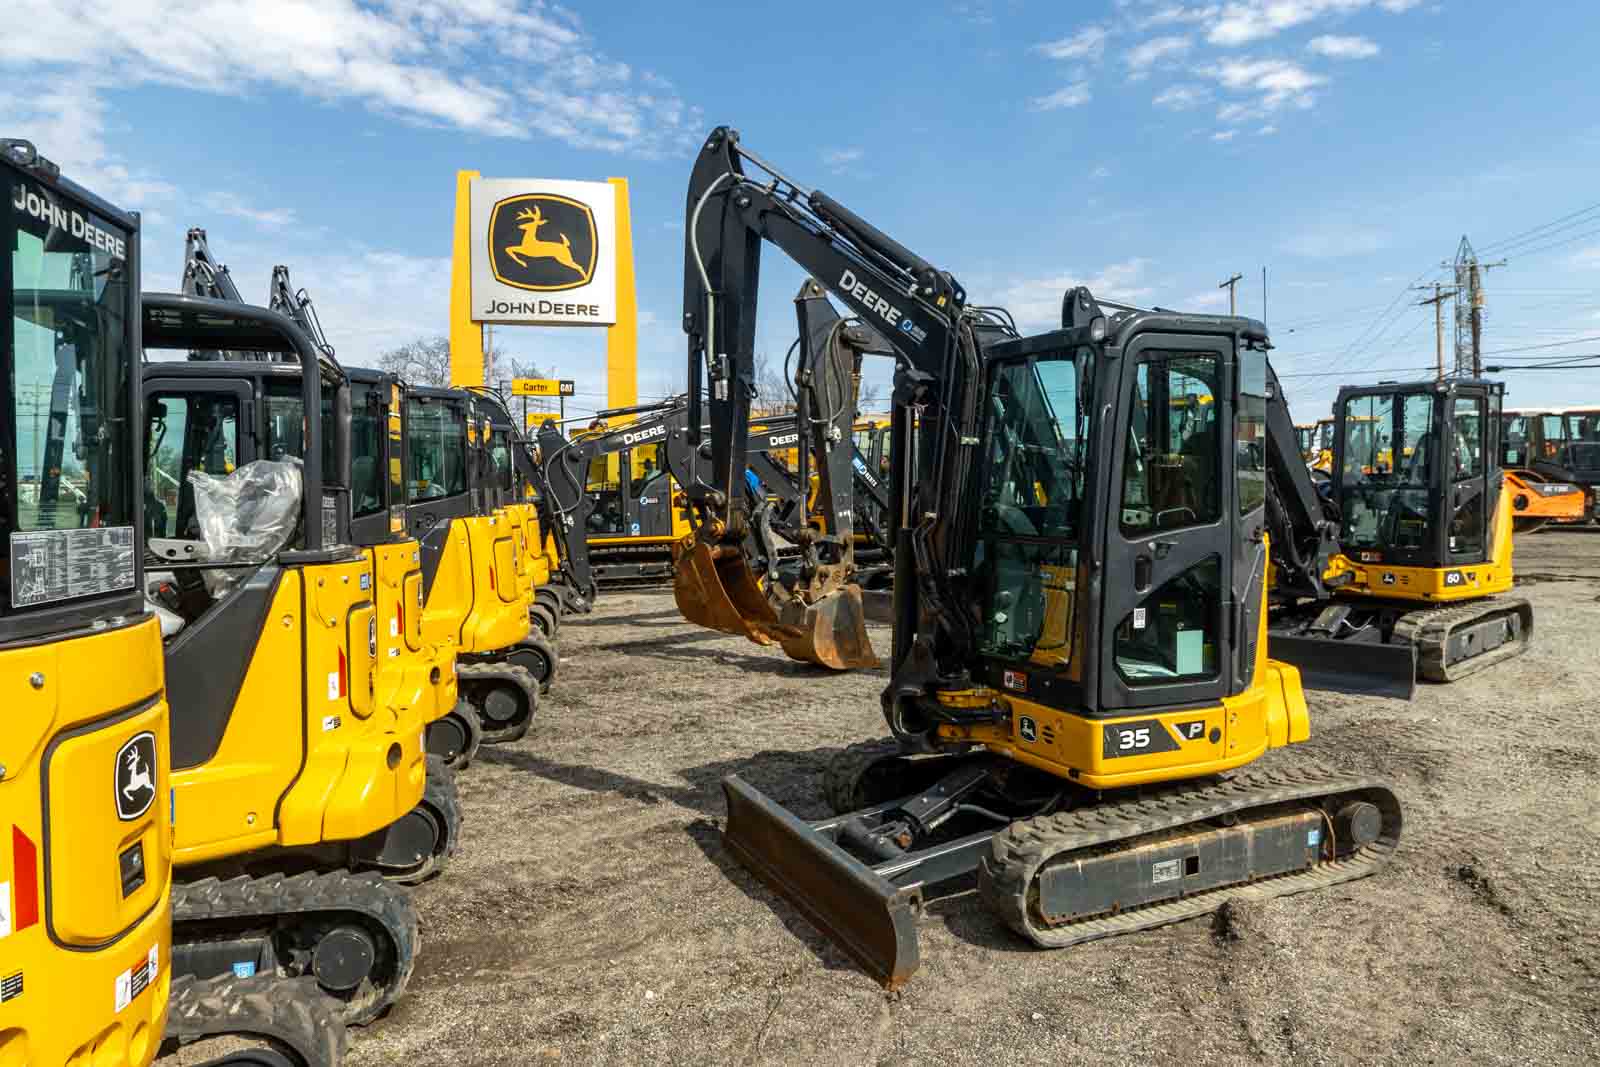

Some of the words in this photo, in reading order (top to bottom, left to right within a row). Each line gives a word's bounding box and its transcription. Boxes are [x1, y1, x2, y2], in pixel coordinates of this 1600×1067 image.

[14, 183, 67, 232] JOHN
[71, 210, 126, 261] DEERE
[839, 269, 902, 326] DEERE
[485, 300, 535, 314] JOHN
[539, 300, 600, 316] DEERE
[524, 382, 548, 392] Carter
[560, 383, 574, 392] CAT
[624, 425, 666, 445] DEERE
[769, 434, 799, 446] DEER
[1447, 573, 1460, 584] 60
[1119, 728, 1150, 749] 35
[1189, 723, 1203, 738] P
